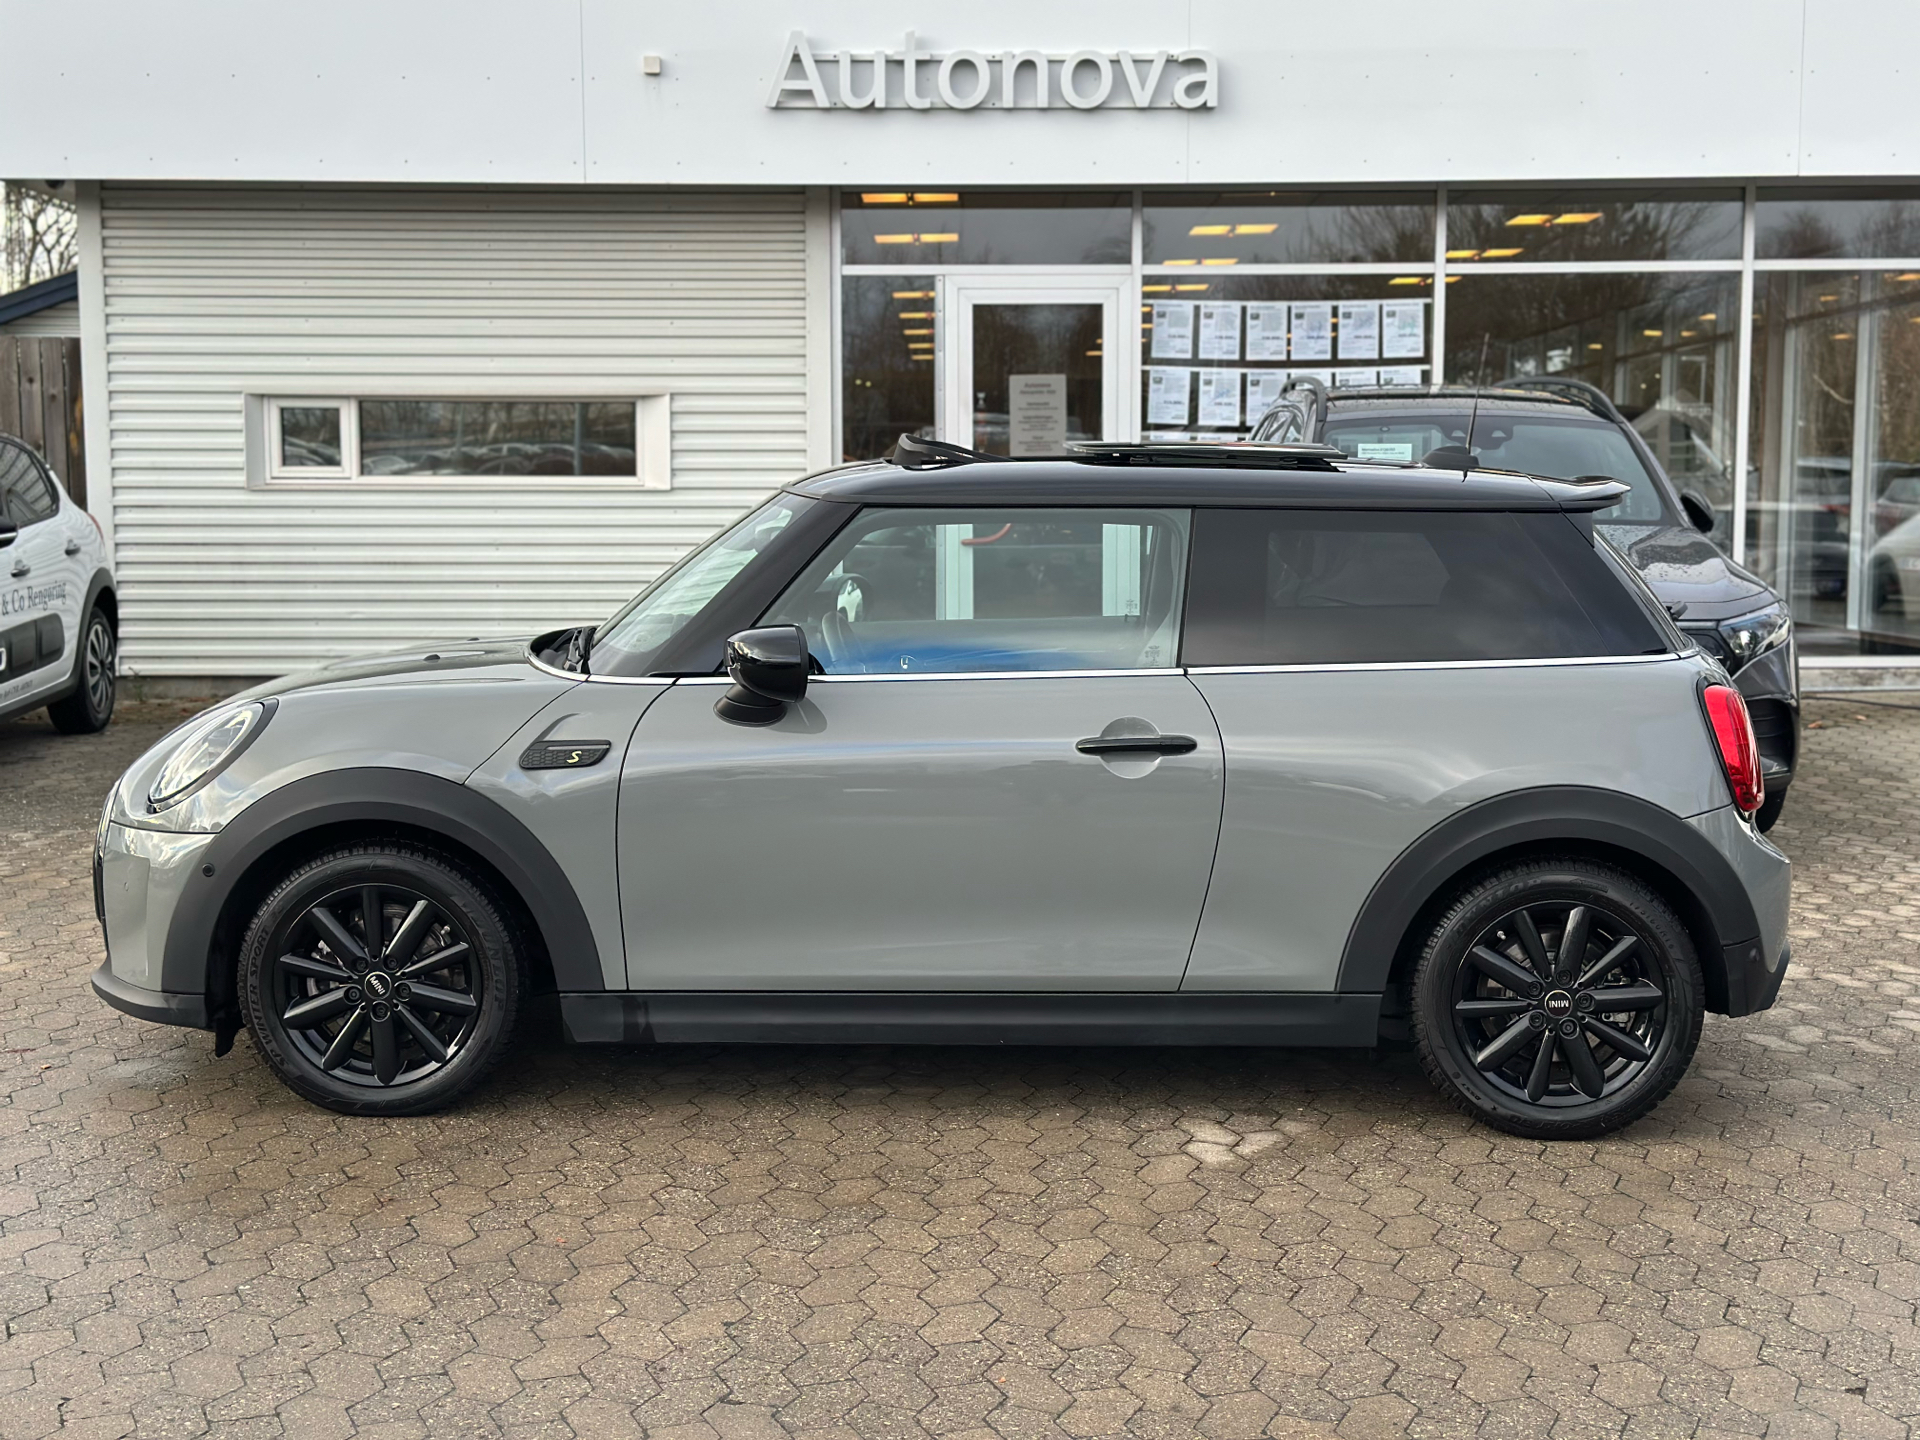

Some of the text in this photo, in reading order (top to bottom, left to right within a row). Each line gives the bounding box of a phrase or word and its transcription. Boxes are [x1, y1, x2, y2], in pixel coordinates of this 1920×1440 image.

[765, 30, 1218, 111] Autonova
[2, 594, 10, 616] &
[12, 589, 25, 612] Co
[566, 750, 583, 764] S
[369, 975, 386, 995] MINI
[248, 926, 289, 1069] SP WINTER SPORT
[1548, 999, 1569, 1009] MINI
